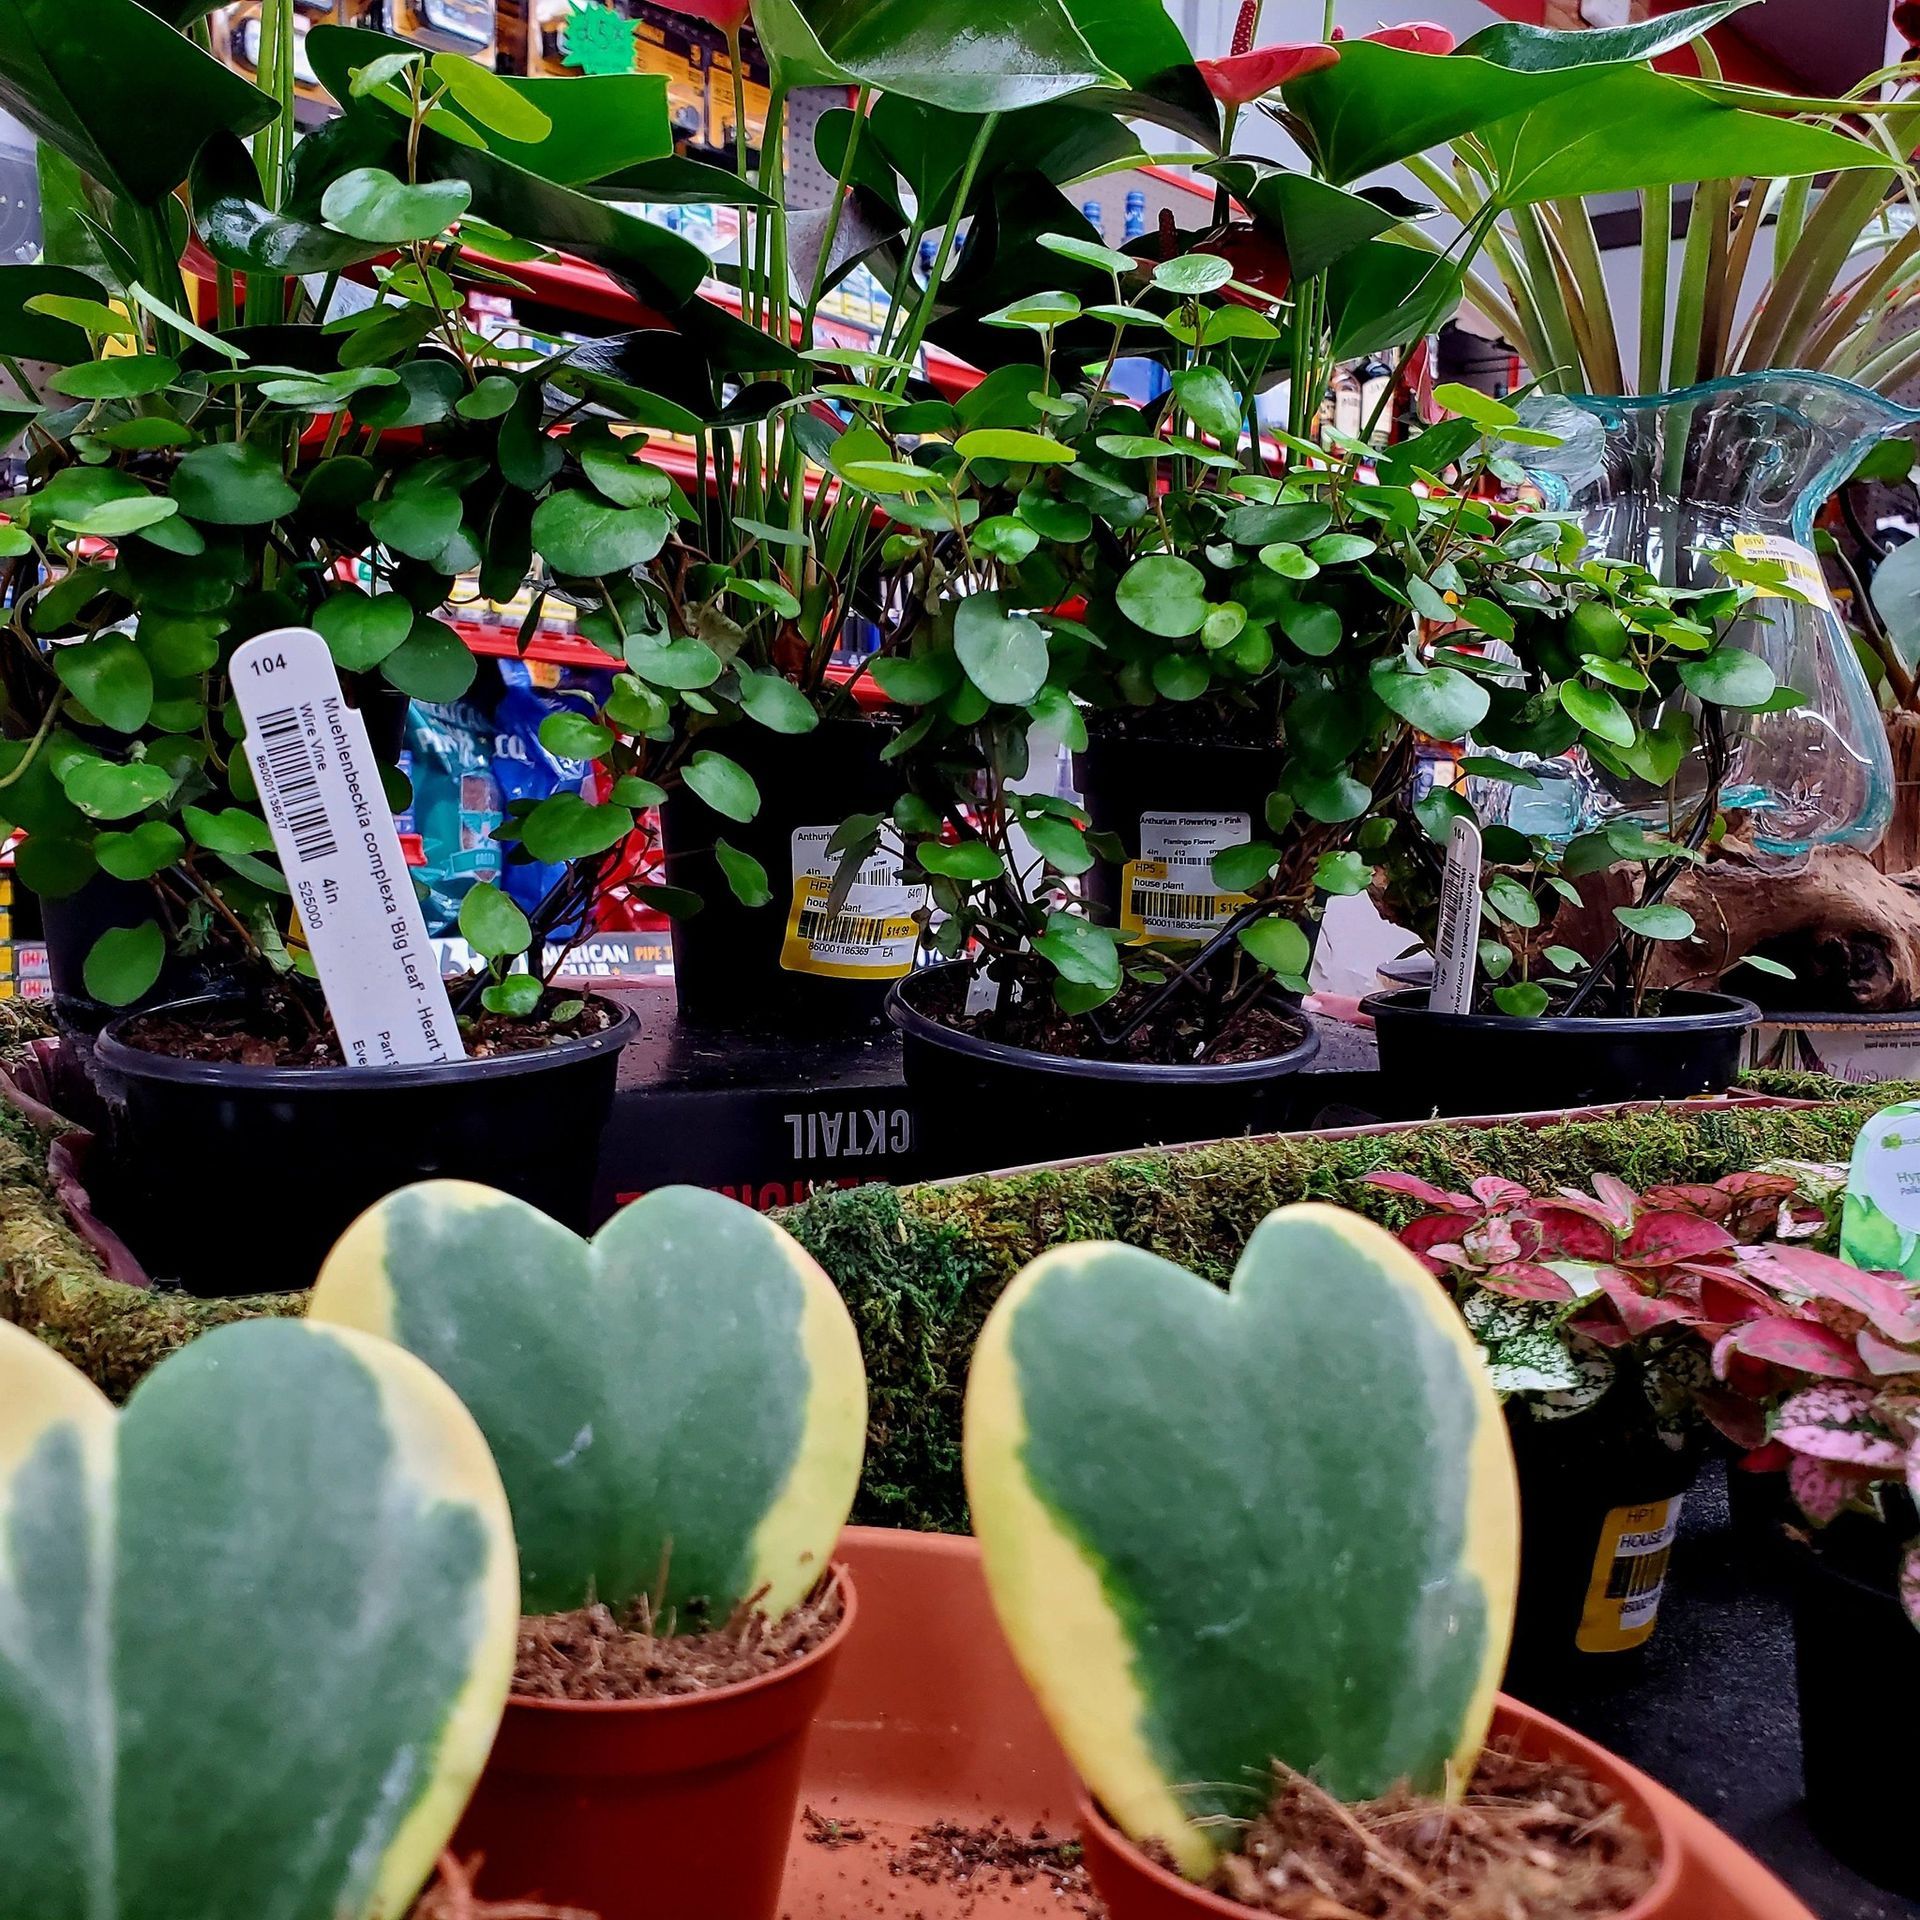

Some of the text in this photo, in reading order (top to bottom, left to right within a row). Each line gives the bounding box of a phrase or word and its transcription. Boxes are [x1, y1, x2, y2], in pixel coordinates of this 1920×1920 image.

[250, 653, 287, 676] 104
[299, 702, 327, 771] Wire Vine
[1140, 817, 1177, 826] Anthurium
[1179, 818, 1217, 827] Flowering
[1224, 817, 1242, 825] Pink
[1163, 838, 1192, 847] Flamingo
[322, 697, 372, 829] Muehlenbeckia
[363, 832, 397, 914] complexa
[417, 1006, 444, 1051] Heart
[1135, 863, 1156, 874] HP5
[322, 878, 340, 905] 4in
[1134, 878, 1185, 892] house plant
[298, 881, 323, 928] 525000
[1460, 872, 1476, 959] Muehlenbeckia
[808, 942, 869, 956] 860001186369
[882, 947, 894, 958] EA
[352, 1039, 369, 1067] Eve
[378, 1031, 396, 1060] Part
[1620, 1529, 1665, 1549] HOUSE
